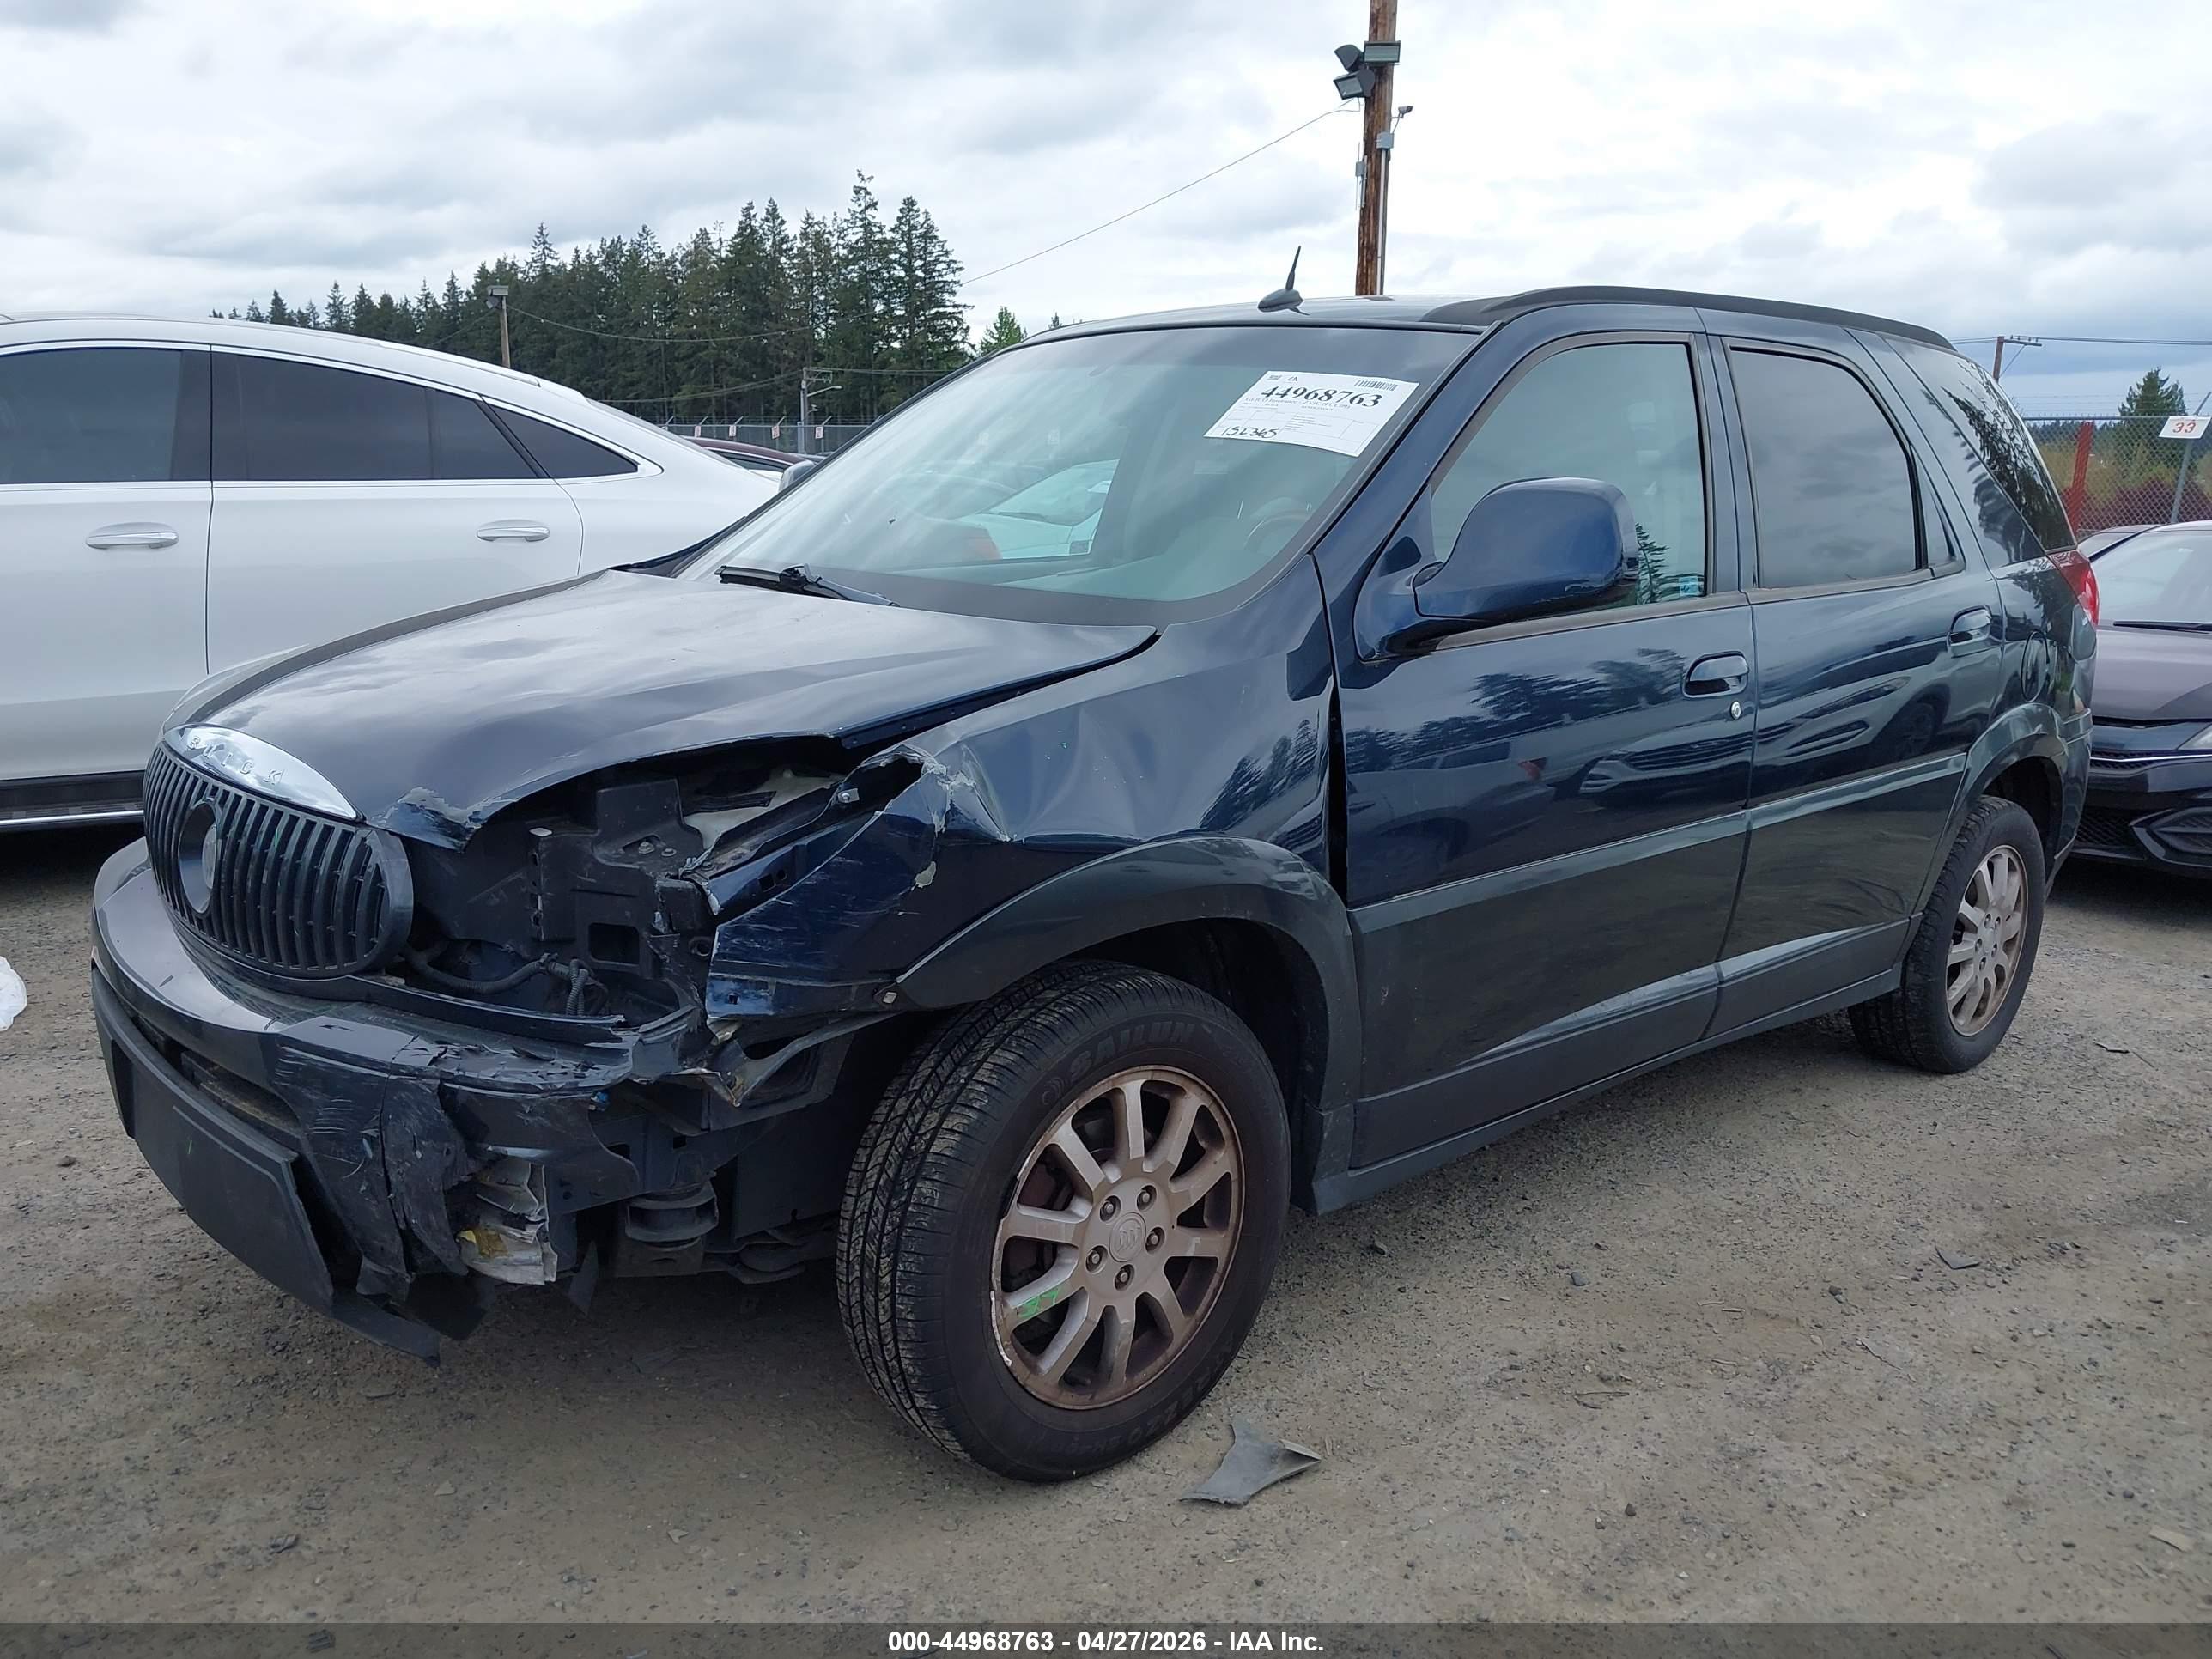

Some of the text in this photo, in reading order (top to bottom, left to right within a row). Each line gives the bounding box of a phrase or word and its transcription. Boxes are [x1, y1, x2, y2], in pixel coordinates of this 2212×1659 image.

[1261, 386, 1382, 407] 44968763
[2172, 422, 2197, 434] 33
[186, 735, 283, 785] BUICK
[1070, 1019, 1197, 1077] SAILUN
